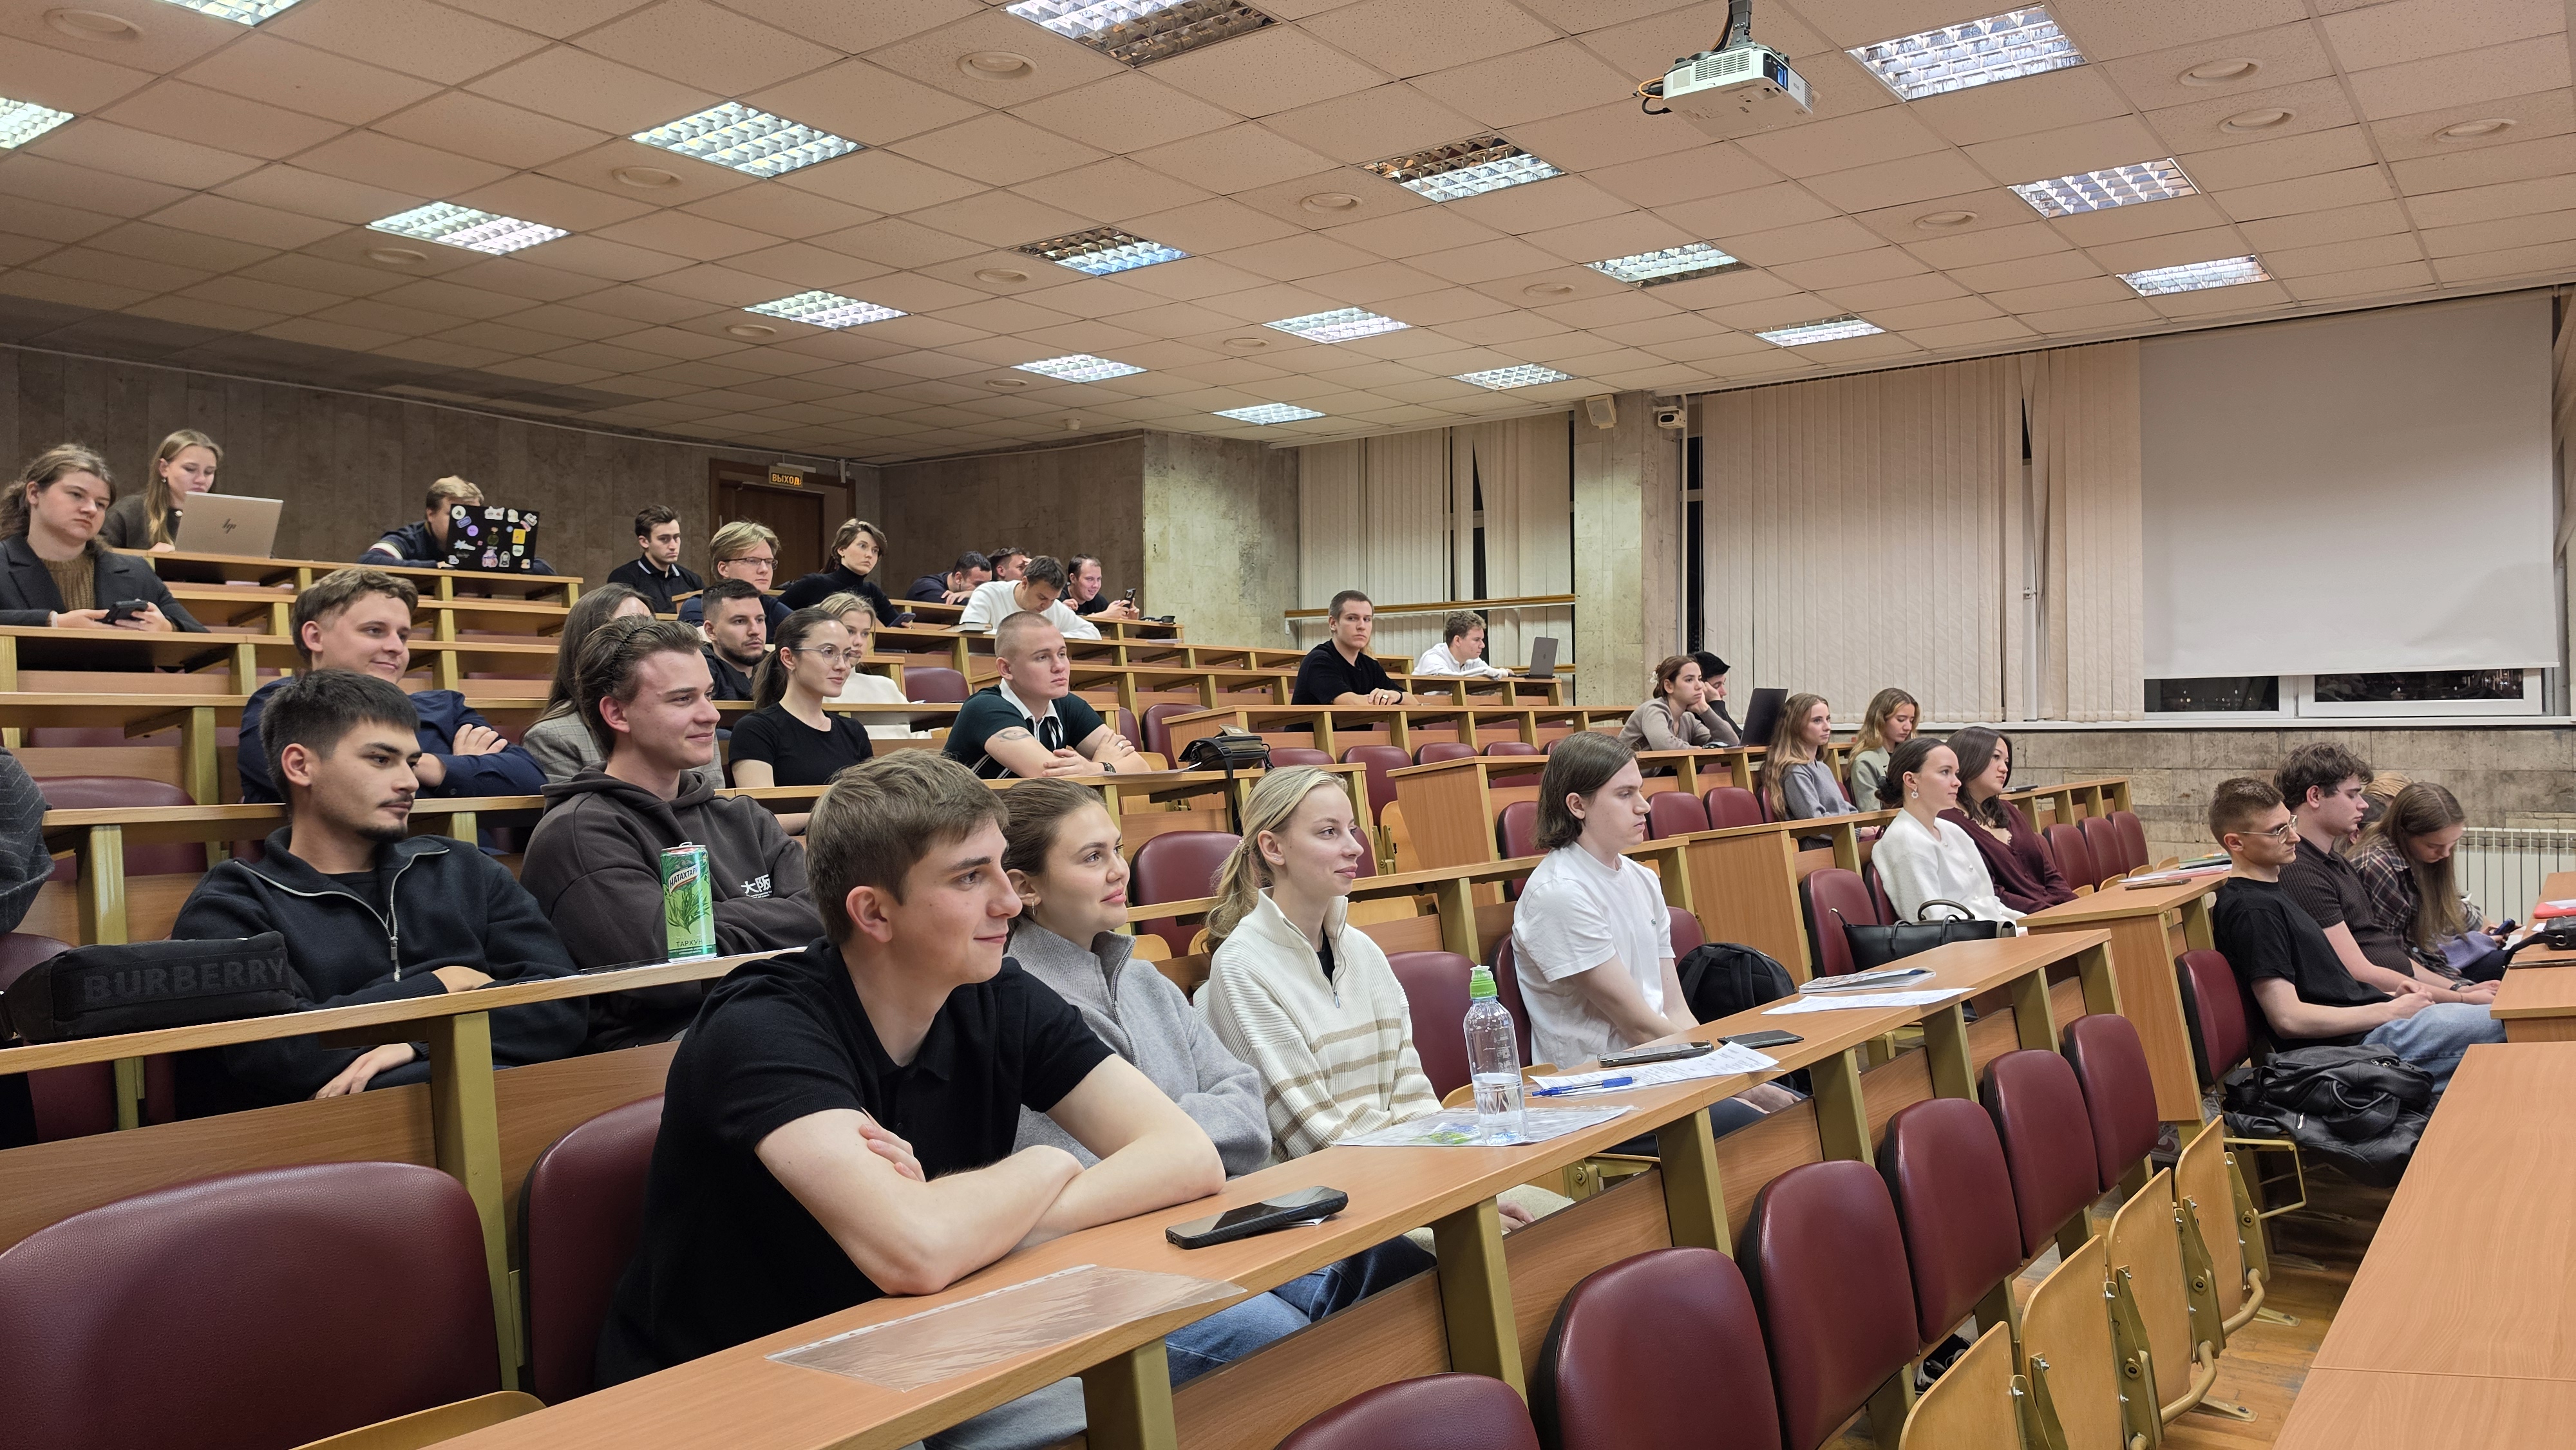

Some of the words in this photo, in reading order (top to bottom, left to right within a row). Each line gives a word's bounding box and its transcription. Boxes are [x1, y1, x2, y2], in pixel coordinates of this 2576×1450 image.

[772, 473, 801, 486] ВЫХОД
[222, 518, 237, 534] hp
[741, 874, 771, 894] 大阪
[83, 957, 285, 1003] BURBERRY
